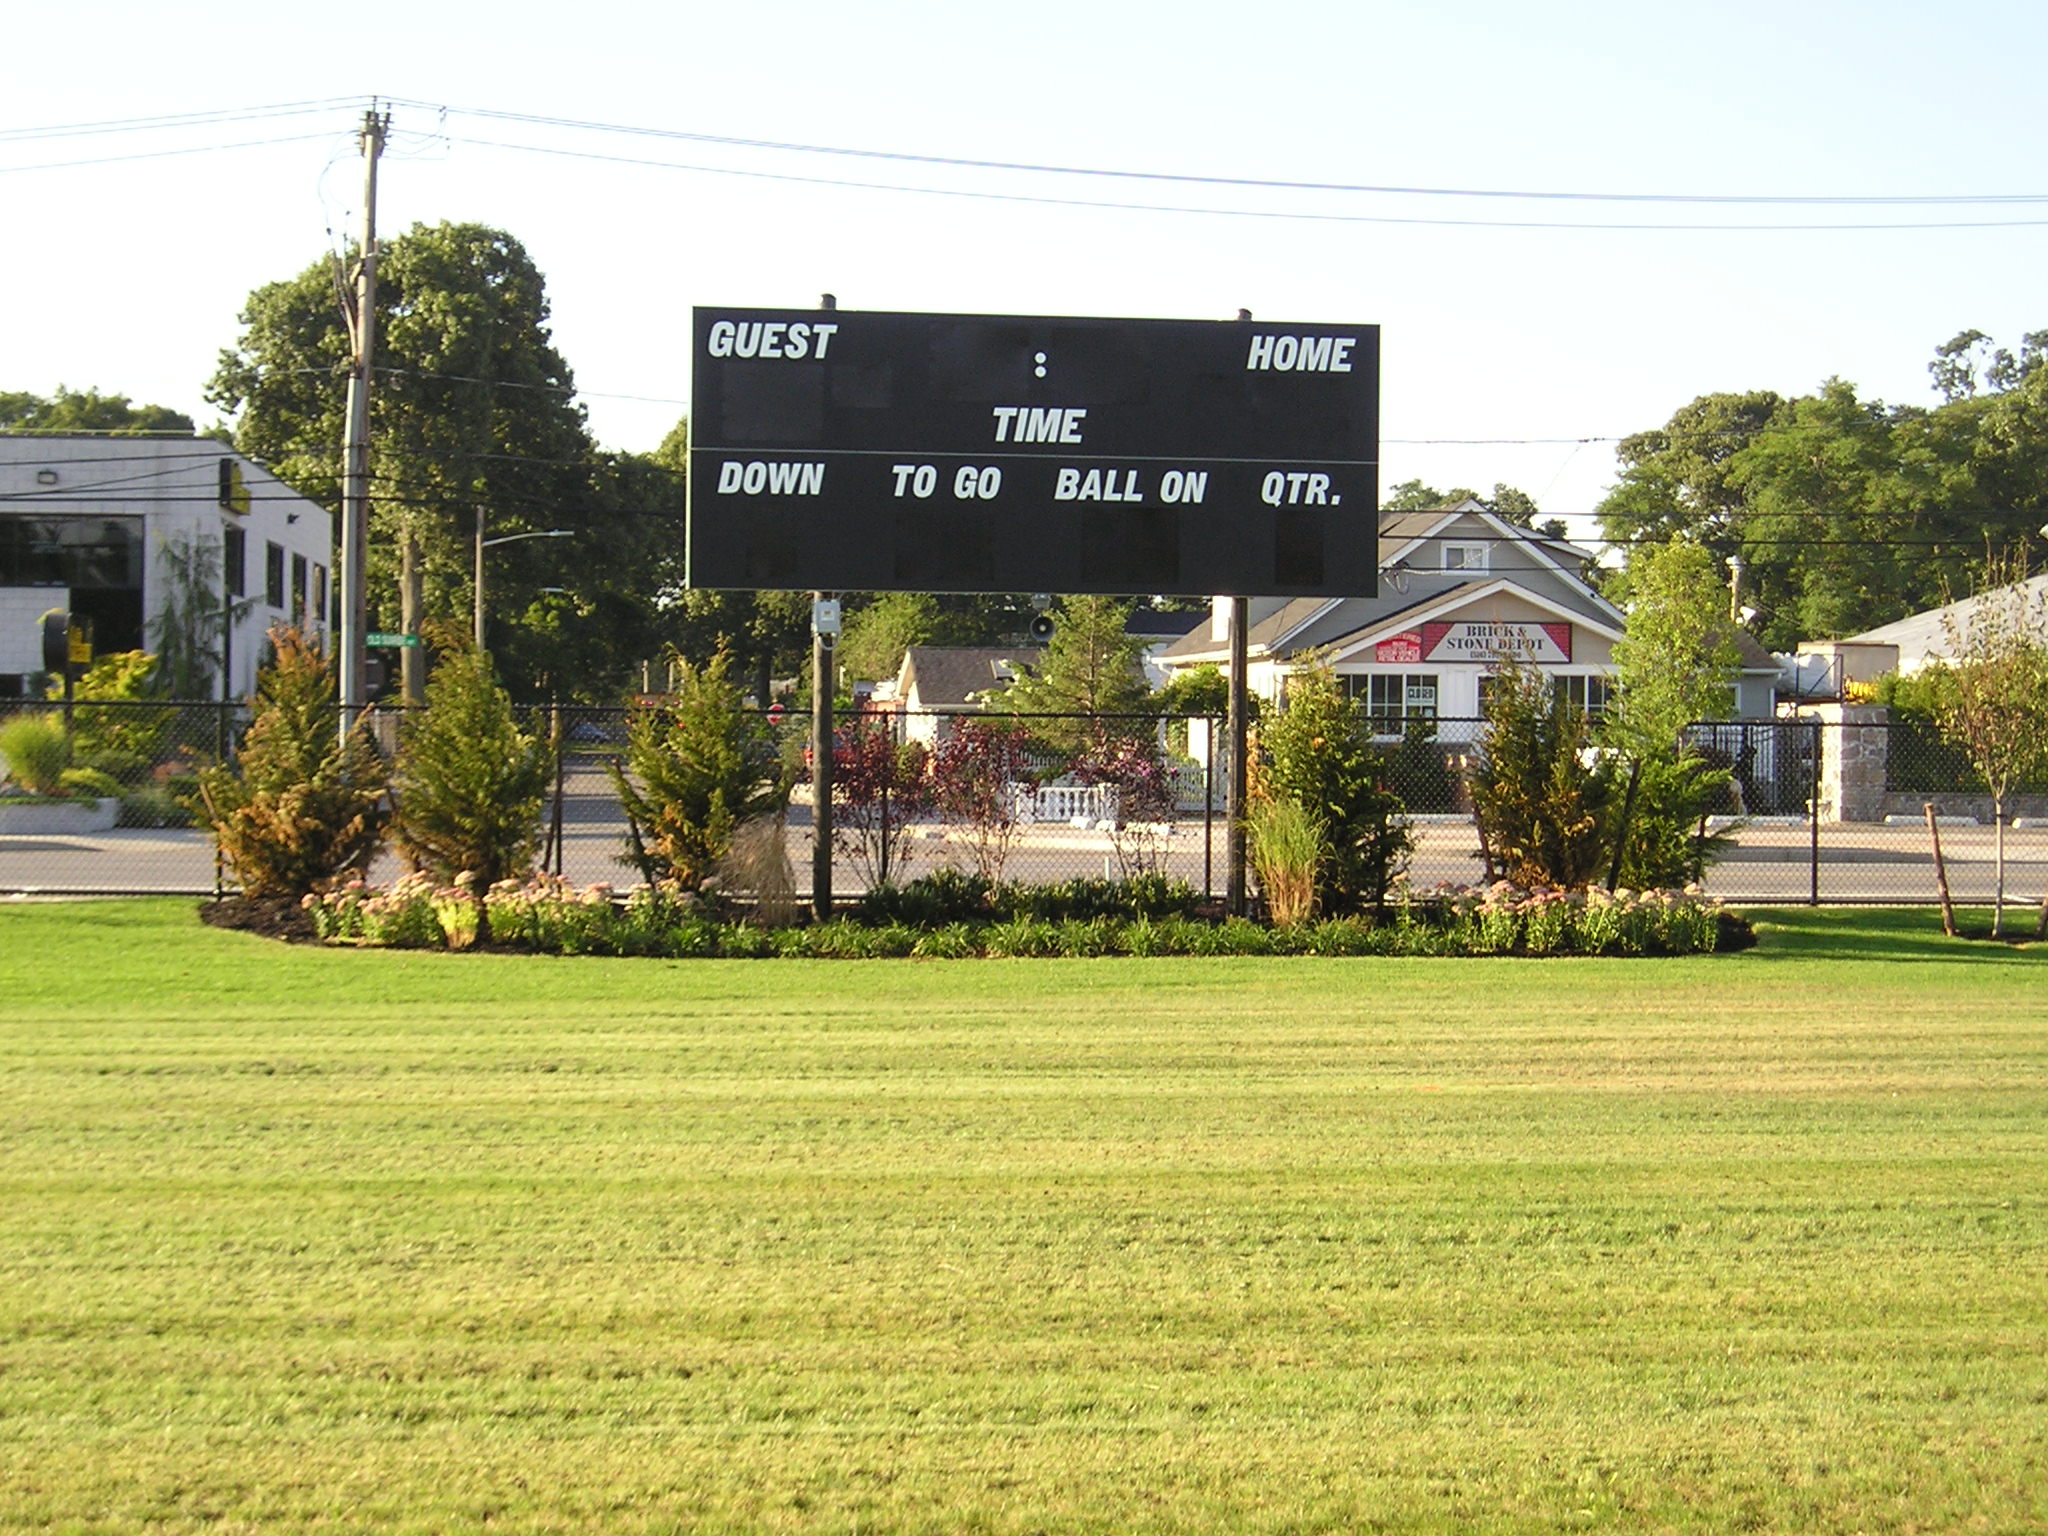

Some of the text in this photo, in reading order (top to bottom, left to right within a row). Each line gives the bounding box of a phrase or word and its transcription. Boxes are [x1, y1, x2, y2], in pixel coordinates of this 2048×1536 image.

[708, 320, 839, 361] GUEST
[1246, 335, 1357, 374] HOME
[992, 406, 1088, 444] TIME
[717, 461, 826, 496] DOWN
[891, 464, 1002, 501] TO GO
[1053, 468, 1208, 505] BALL ON
[1261, 471, 1342, 508] QTR.
[1446, 638, 1545, 650] STONE DEPOT
[1466, 625, 1514, 637] BRICK
[1408, 688, 1434, 699] CLOSED
